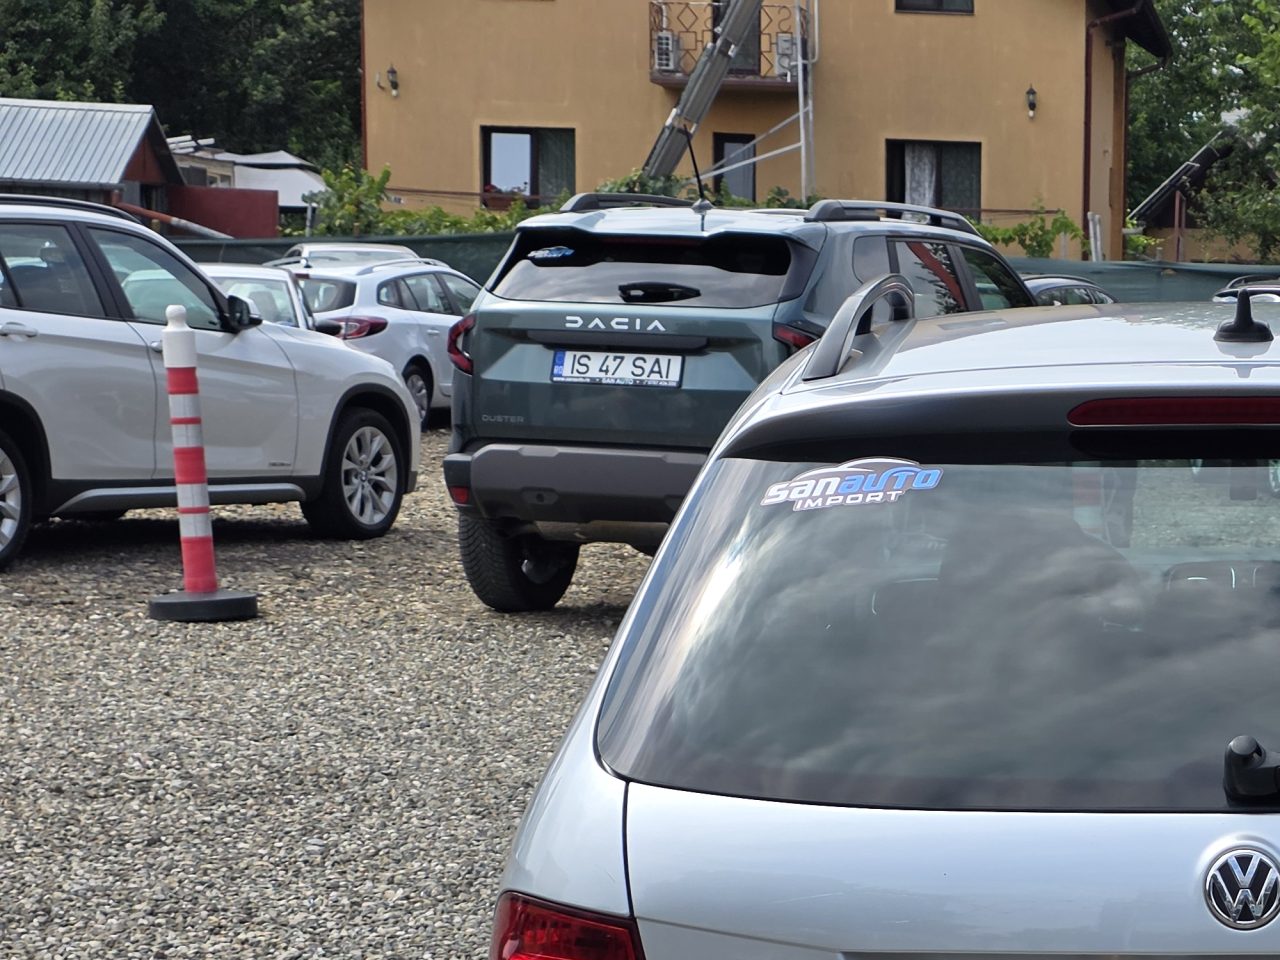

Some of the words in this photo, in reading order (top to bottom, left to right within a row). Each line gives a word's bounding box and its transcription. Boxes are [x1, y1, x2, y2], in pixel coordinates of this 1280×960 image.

[565, 316, 666, 331] DACIA
[571, 354, 592, 375] IS
[599, 355, 625, 376] 47
[631, 356, 671, 379] SAI
[482, 414, 524, 423] DUSTER
[796, 491, 903, 510] IMPORT
